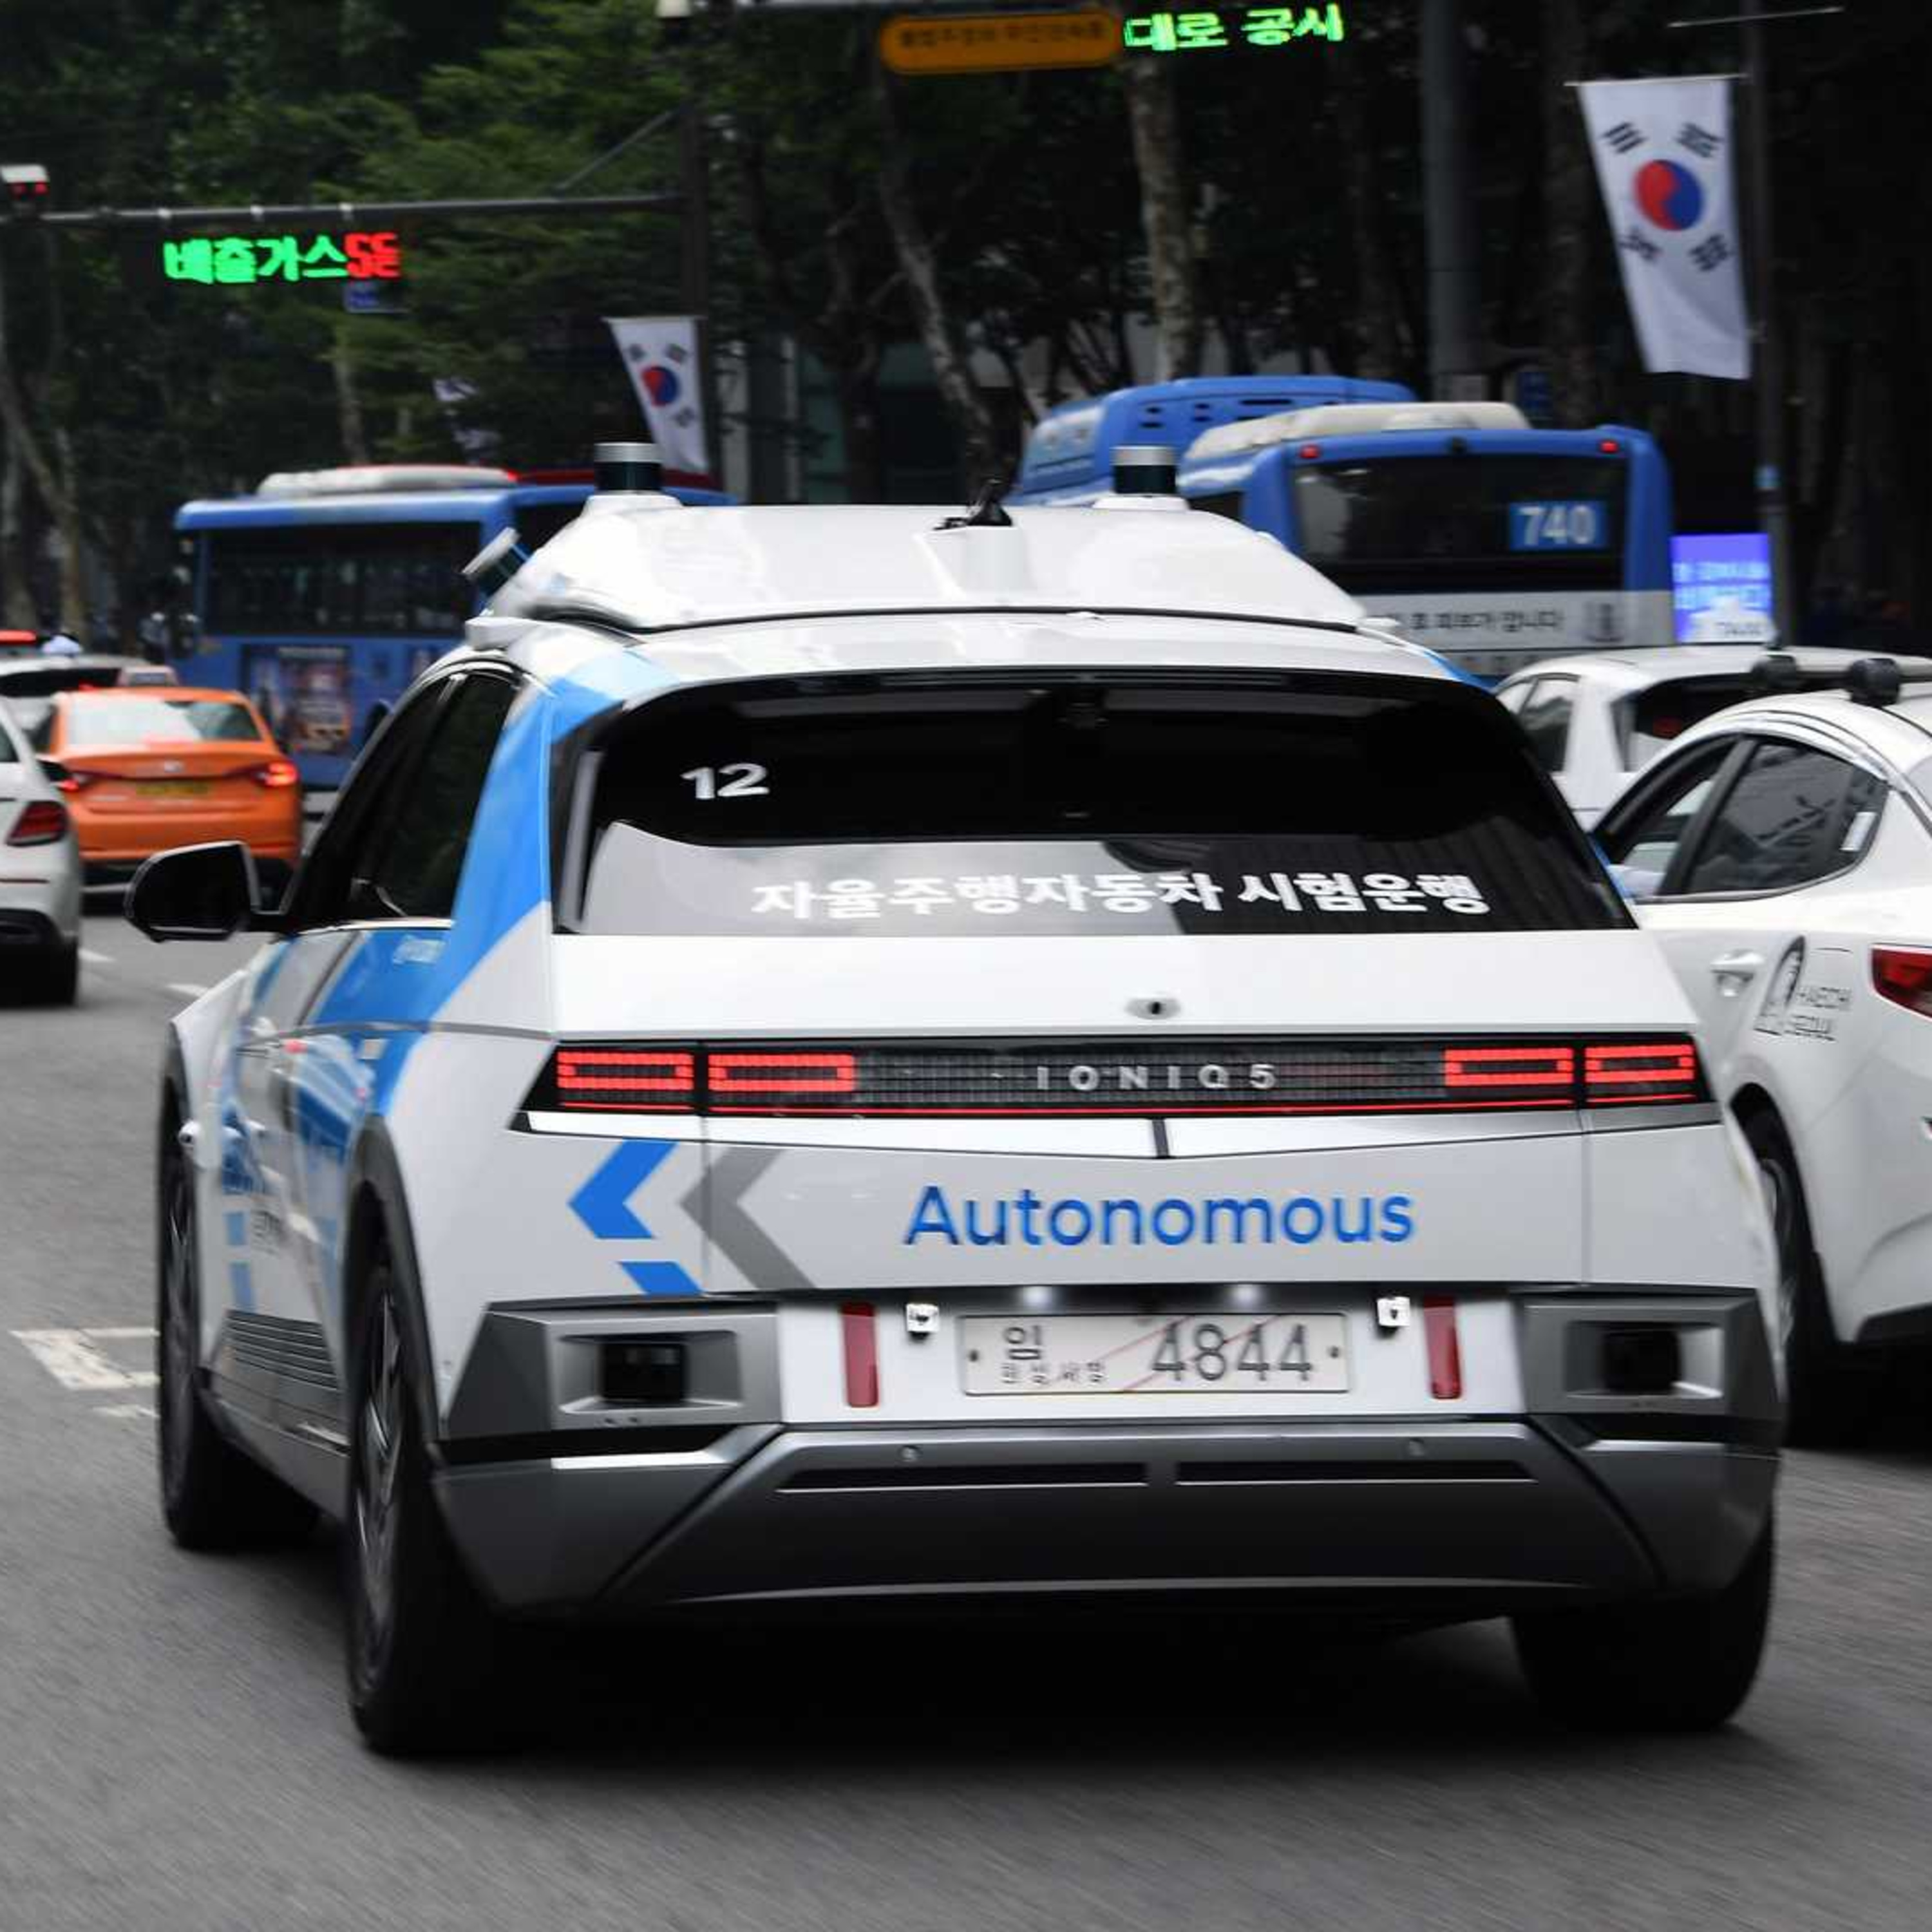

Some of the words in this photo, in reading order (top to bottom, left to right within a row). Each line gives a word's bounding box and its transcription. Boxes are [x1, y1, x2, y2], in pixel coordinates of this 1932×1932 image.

[1518, 505, 1598, 545] 740
[683, 763, 770, 800] 12
[750, 873, 1222, 920] 자율주행자동차
[1239, 873, 1489, 914] 시험운행
[904, 1185, 1415, 1248] Autonomous
[1151, 1323, 1314, 1382] 4844
